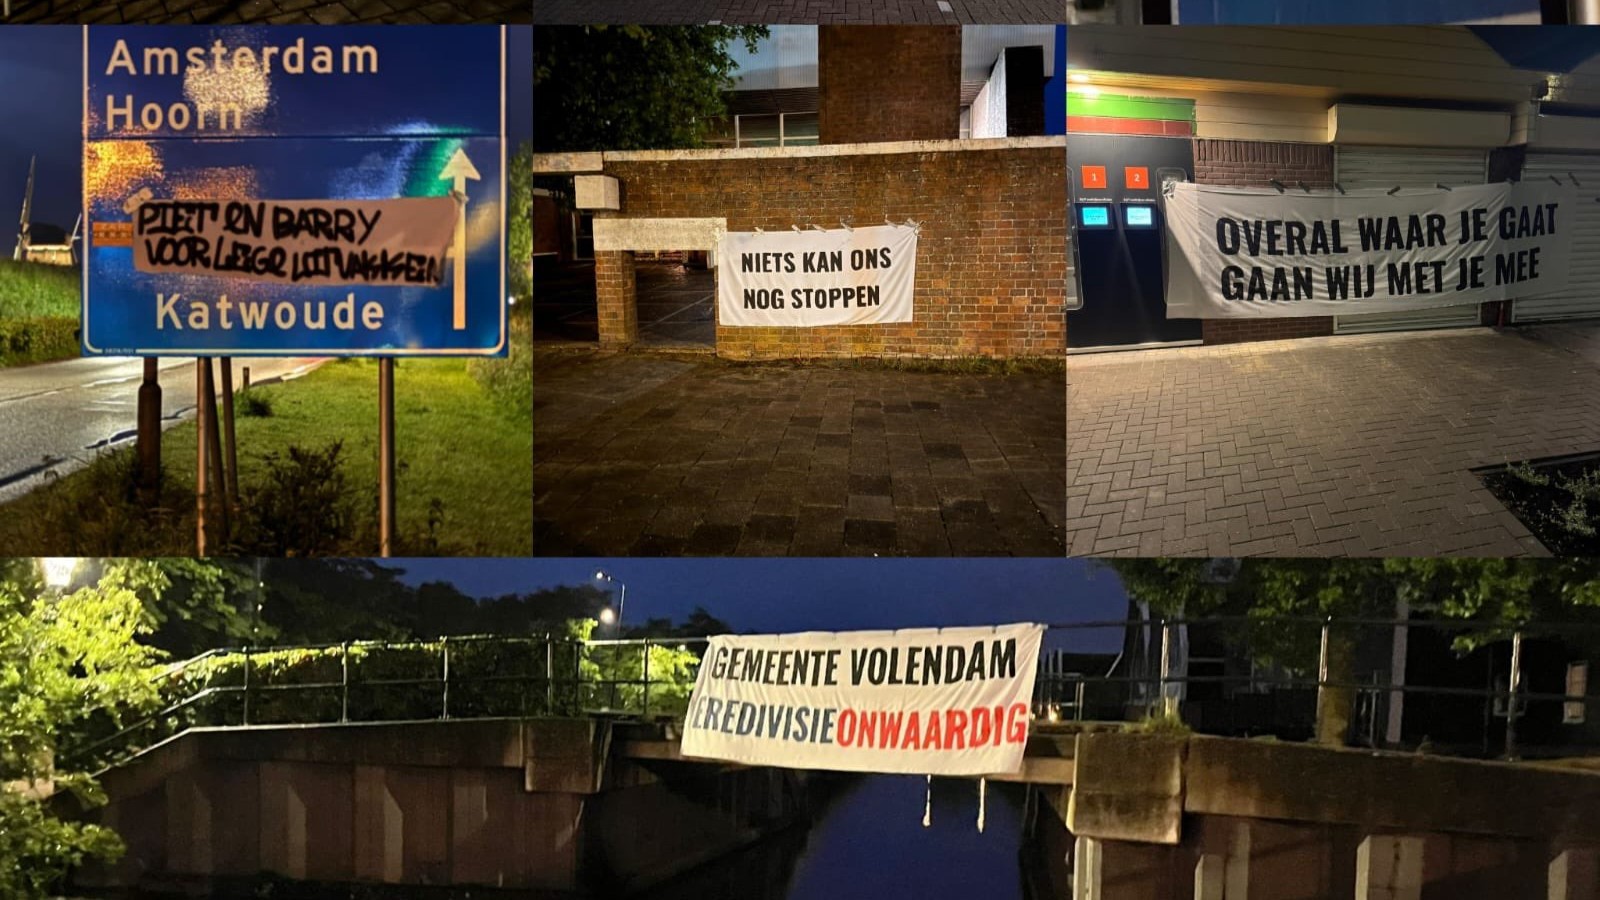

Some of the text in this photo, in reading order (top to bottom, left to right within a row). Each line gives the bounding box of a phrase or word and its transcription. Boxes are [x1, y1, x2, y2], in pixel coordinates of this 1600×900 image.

[105, 38, 379, 76] Amsterdam
[106, 95, 244, 131] Hoorn
[138, 201, 219, 236] PIET
[272, 206, 382, 245] BARRY
[1216, 203, 1559, 257] OVERAL WAAR JE GAAT
[145, 236, 211, 268] VOOR
[741, 246, 892, 273] NIETS KAN ONS
[1221, 247, 1540, 302] GAAN WIJ MET JE MEE
[155, 293, 385, 330] Katwoude
[743, 285, 880, 309] NOG STOPPEN
[711, 638, 1016, 687] GEMEENTE VOLENDAM
